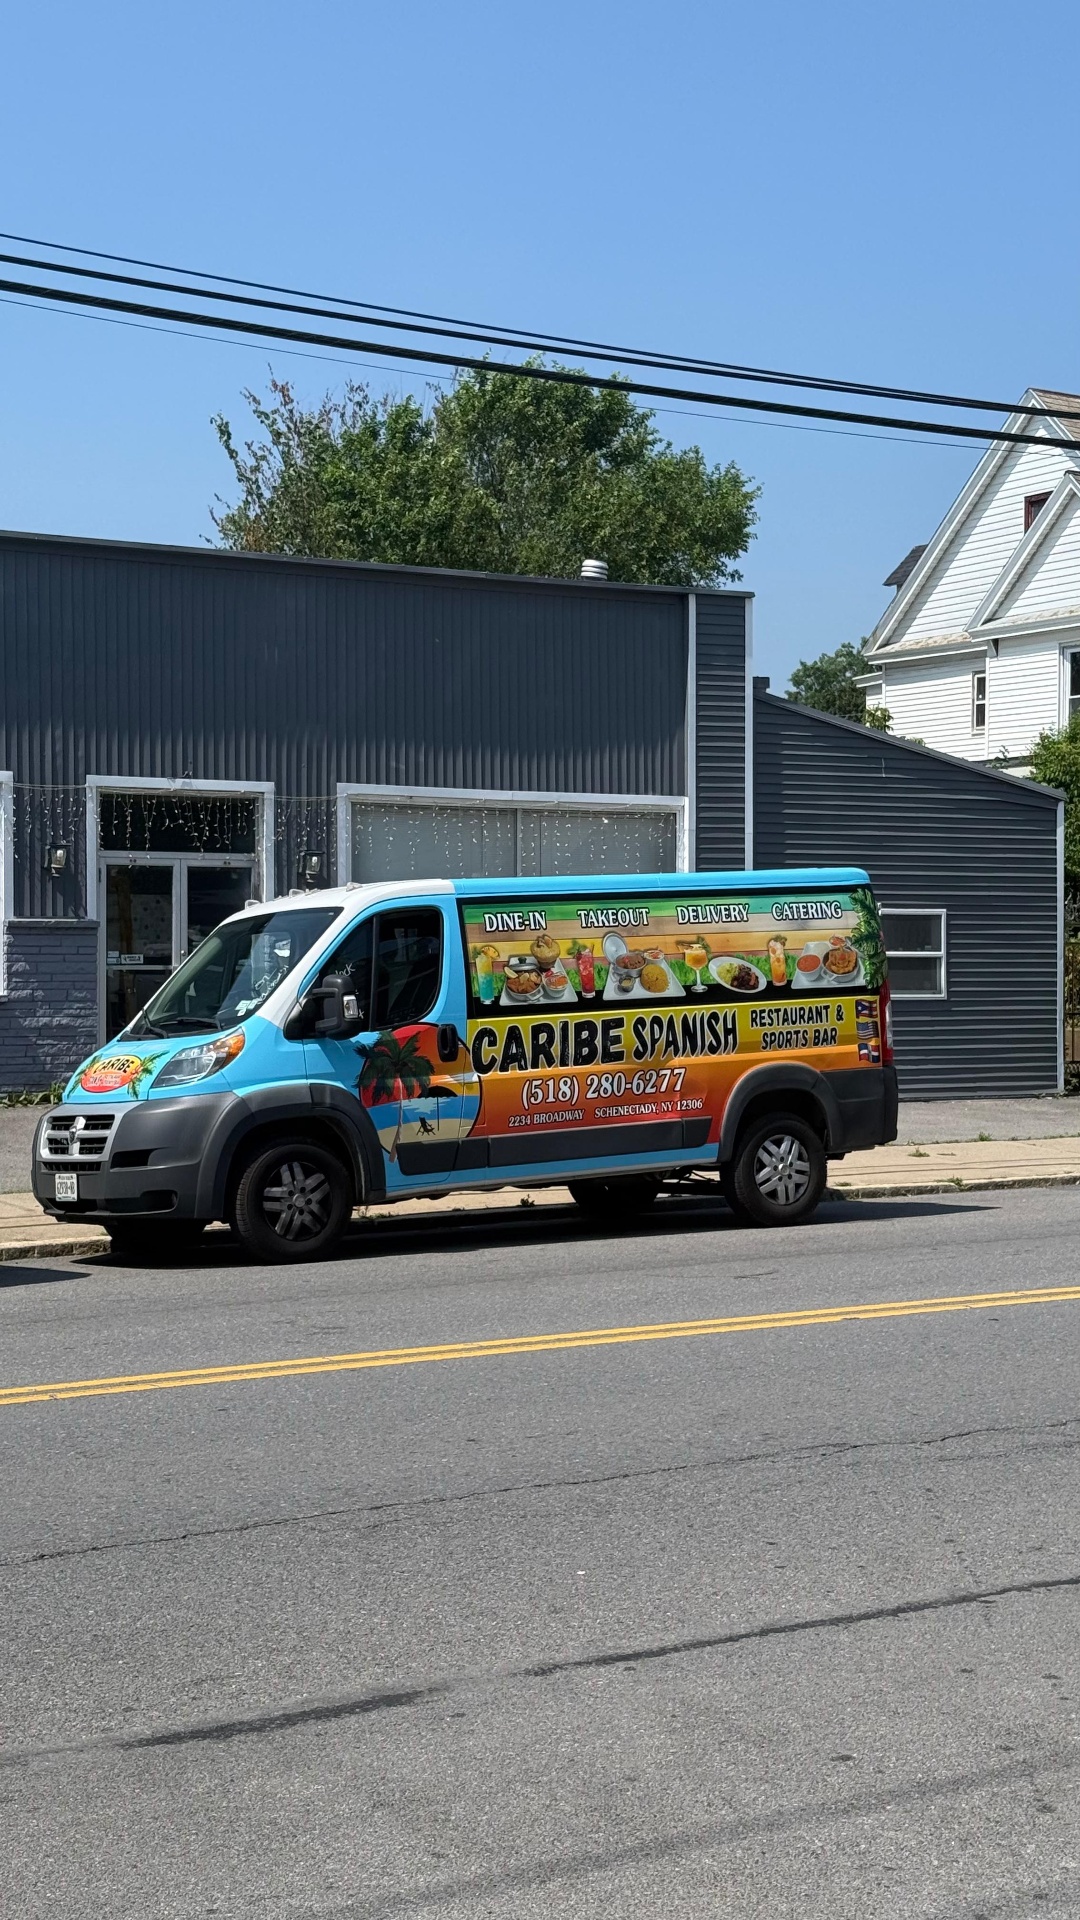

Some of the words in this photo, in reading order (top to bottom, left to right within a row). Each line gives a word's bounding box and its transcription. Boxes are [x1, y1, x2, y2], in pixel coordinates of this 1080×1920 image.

[484, 911, 547, 932] DINE-IN
[577, 908, 649, 928] TAKEOUT
[676, 904, 749, 924] DELIVERY
[772, 901, 842, 920] CATERING
[750, 1004, 830, 1028] RESTAURANT
[835, 1004, 844, 1022] &
[472, 1017, 625, 1075] CARIBE
[632, 1009, 738, 1062] SPANISH
[761, 1029, 809, 1050] SPORTS
[812, 1027, 838, 1047] BAR
[93, 1058, 135, 1074] CARIBE
[521, 1075, 579, 1109] (518)
[586, 1068, 686, 1100] 280-6277
[508, 1115, 531, 1127] 2234
[533, 1109, 585, 1125] BROADWAY
[595, 1103, 659, 1118] SCHENECTADY,
[661, 1101, 673, 1112] NY
[676, 1099, 703, 1111] 12306
